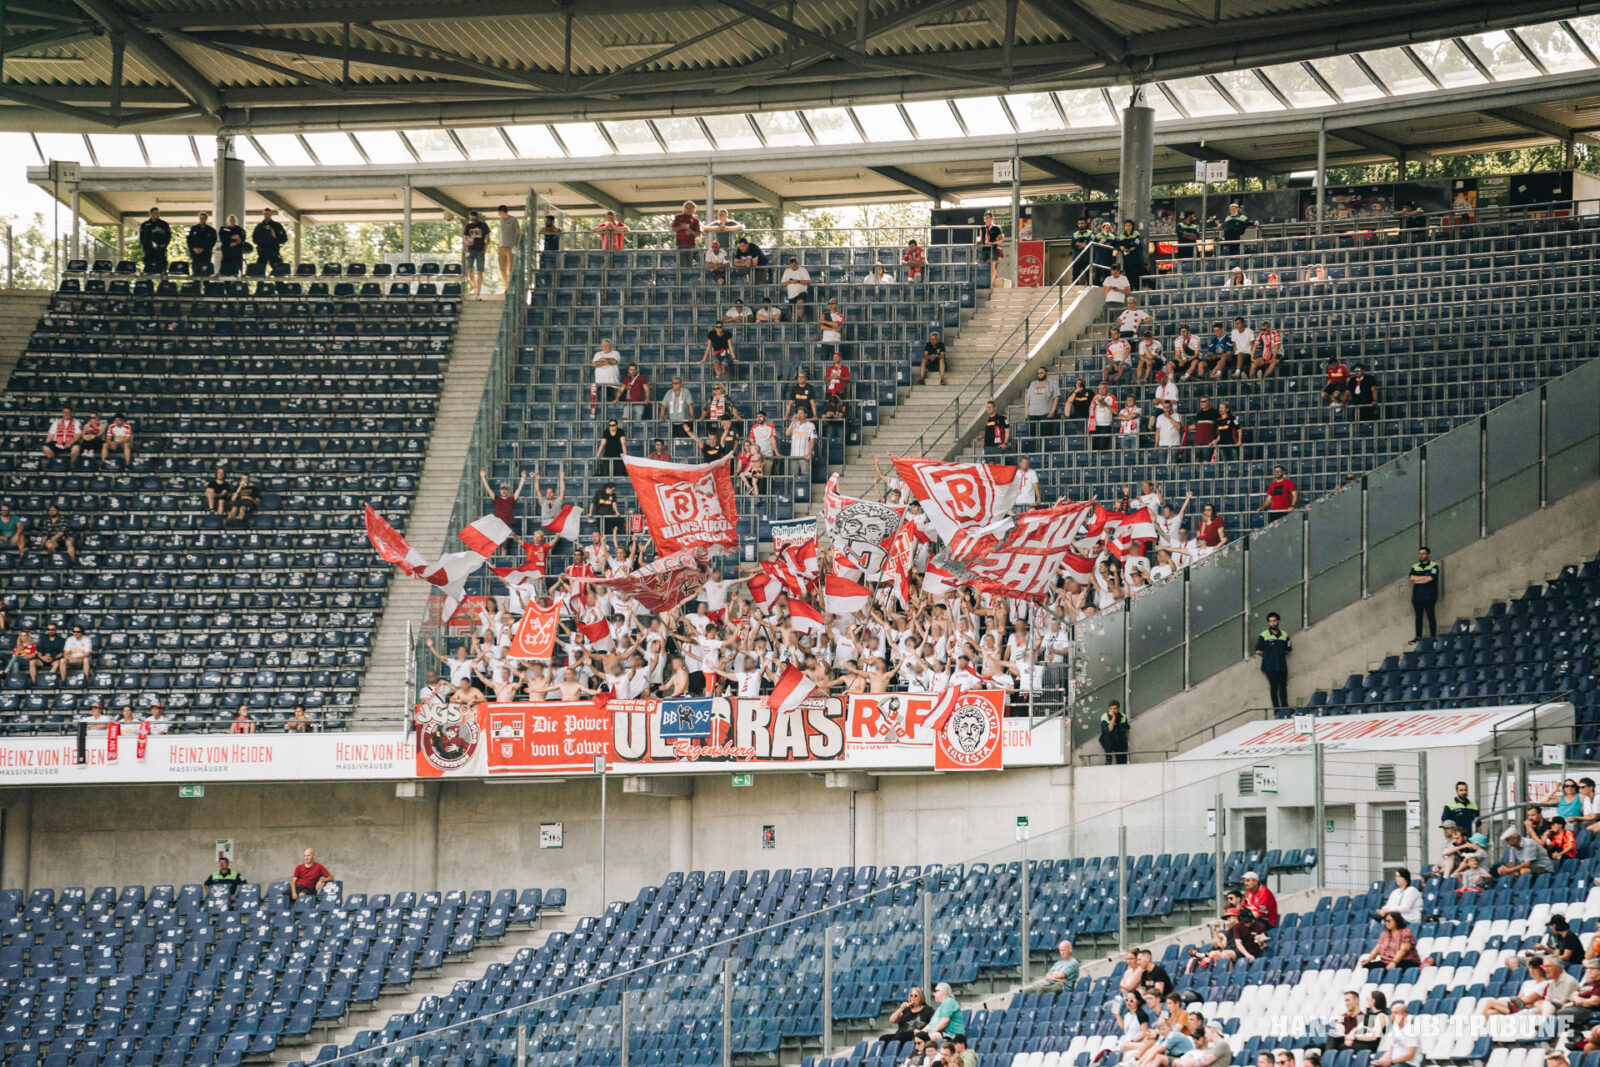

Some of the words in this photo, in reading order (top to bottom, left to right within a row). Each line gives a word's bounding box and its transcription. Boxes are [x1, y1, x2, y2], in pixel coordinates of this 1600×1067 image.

[532, 715, 558, 733] Die
[563, 714, 609, 735] Power
[663, 710, 678, 725] BB
[695, 710, 710, 724] 95
[1317, 719, 1399, 741] VON
[1370, 713, 1499, 738] HEIDEN
[531, 741, 560, 756] vom
[563, 738, 609, 756] Tower
[1003, 729, 1032, 747] EIDEN
[0, 747, 34, 767] HEINZ
[37, 749, 60, 766] VON
[63, 746, 105, 766] HEDEN
[170, 744, 203, 764] HEINZ
[206, 746, 229, 763] VON
[232, 743, 273, 763] HEIDEN
[336, 742, 369, 761] HEINZ
[372, 744, 394, 761] VON
[396, 741, 414, 761] HEI
[673, 739, 755, 761] Regensburg
